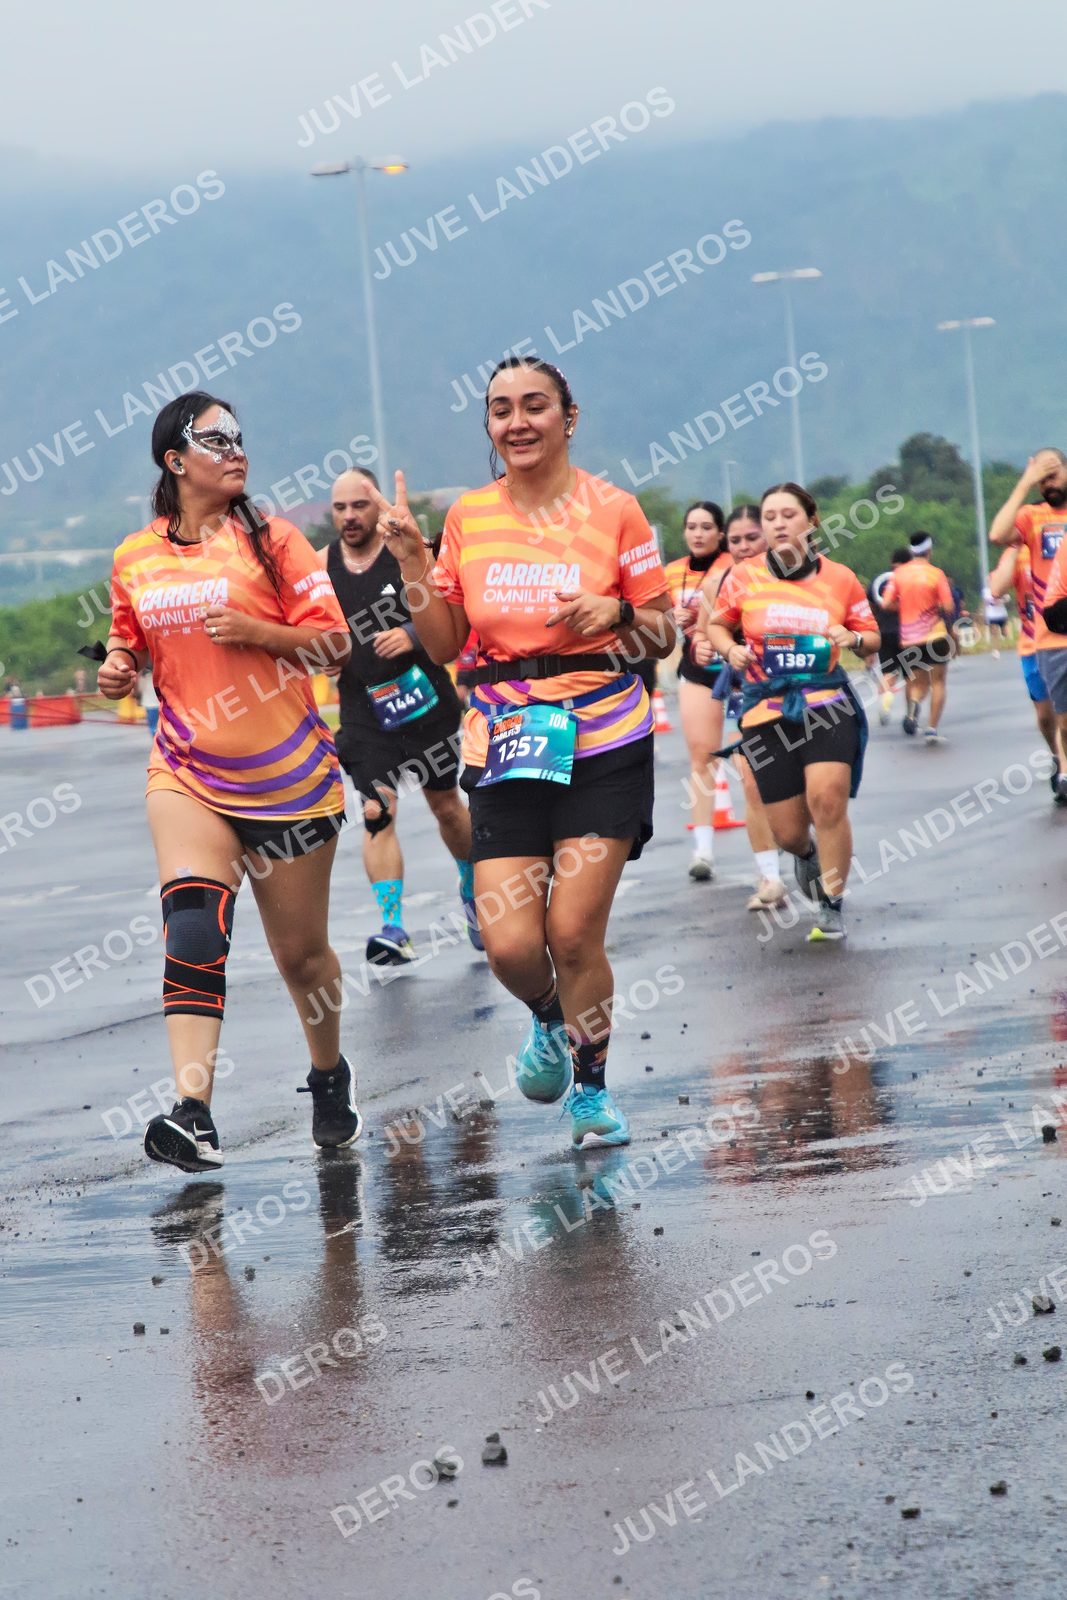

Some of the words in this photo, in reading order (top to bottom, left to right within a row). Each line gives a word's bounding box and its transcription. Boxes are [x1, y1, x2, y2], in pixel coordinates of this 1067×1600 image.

[486, 563, 581, 586] CARRERA
[139, 577, 228, 612] CARRERA
[483, 588, 557, 603] OMNILIFE
[776, 653, 816, 668] 1387
[385, 687, 424, 714] 1441
[549, 713, 569, 730] 10K
[498, 736, 549, 763] 1257
